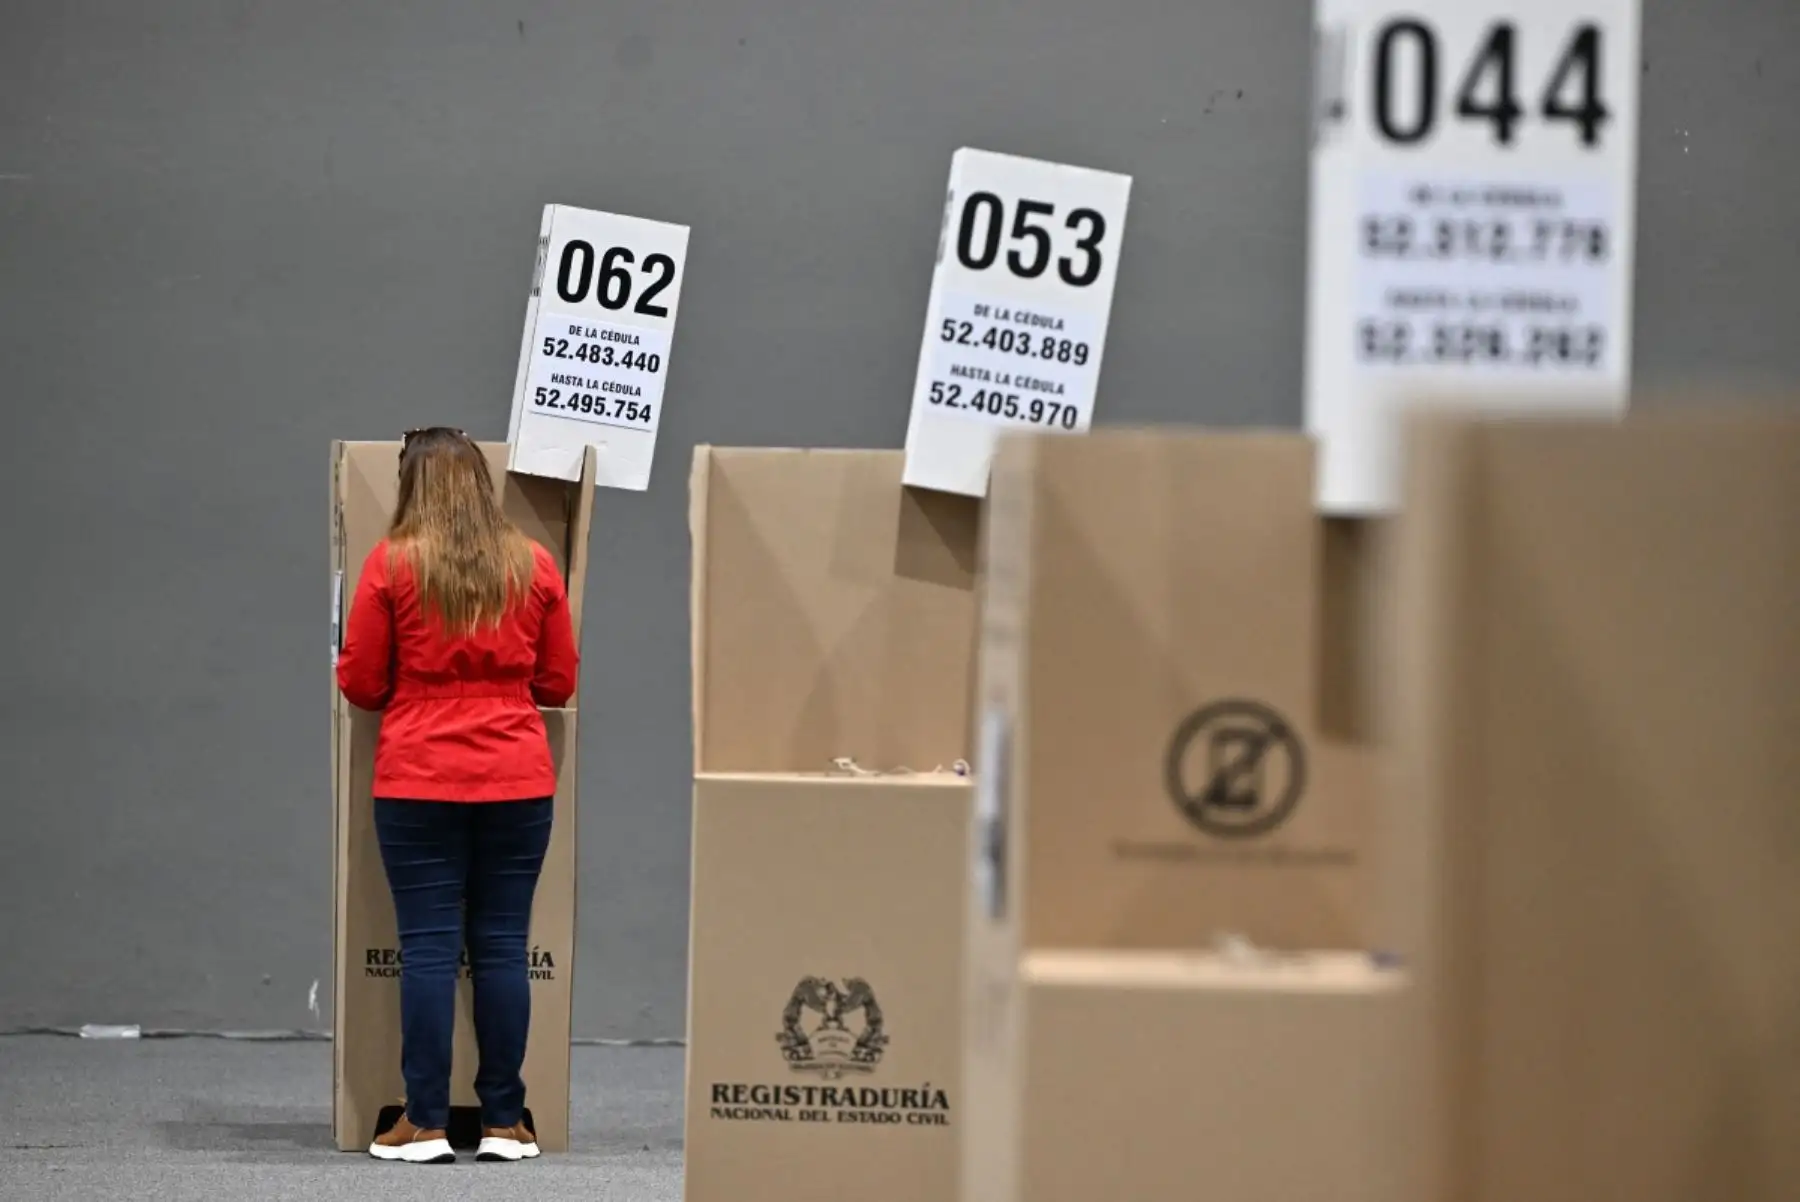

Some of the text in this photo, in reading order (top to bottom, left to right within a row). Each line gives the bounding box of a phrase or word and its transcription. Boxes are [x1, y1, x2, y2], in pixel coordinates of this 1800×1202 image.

[1373, 19, 1608, 147] 044
[957, 191, 1106, 287] 053
[556, 240, 675, 318] 062
[974, 304, 1064, 330] DE LA CÉDULA
[569, 325, 640, 345] DE LA CÉDULA
[940, 319, 1089, 366] 52.403.889
[542, 337, 660, 373] 52.483.440
[551, 373, 641, 396] HASTA LA CÉDULA
[950, 364, 1065, 395] HASTA LA CÉDULA
[534, 387, 651, 422] 52.495.754
[929, 381, 1078, 430] 52.405.970
[528, 970, 555, 980] IVIL
[711, 1081, 950, 1110] REGISTRADURÍA
[710, 1107, 951, 1126] NACIONAL DEL ESTADO CIVIL
